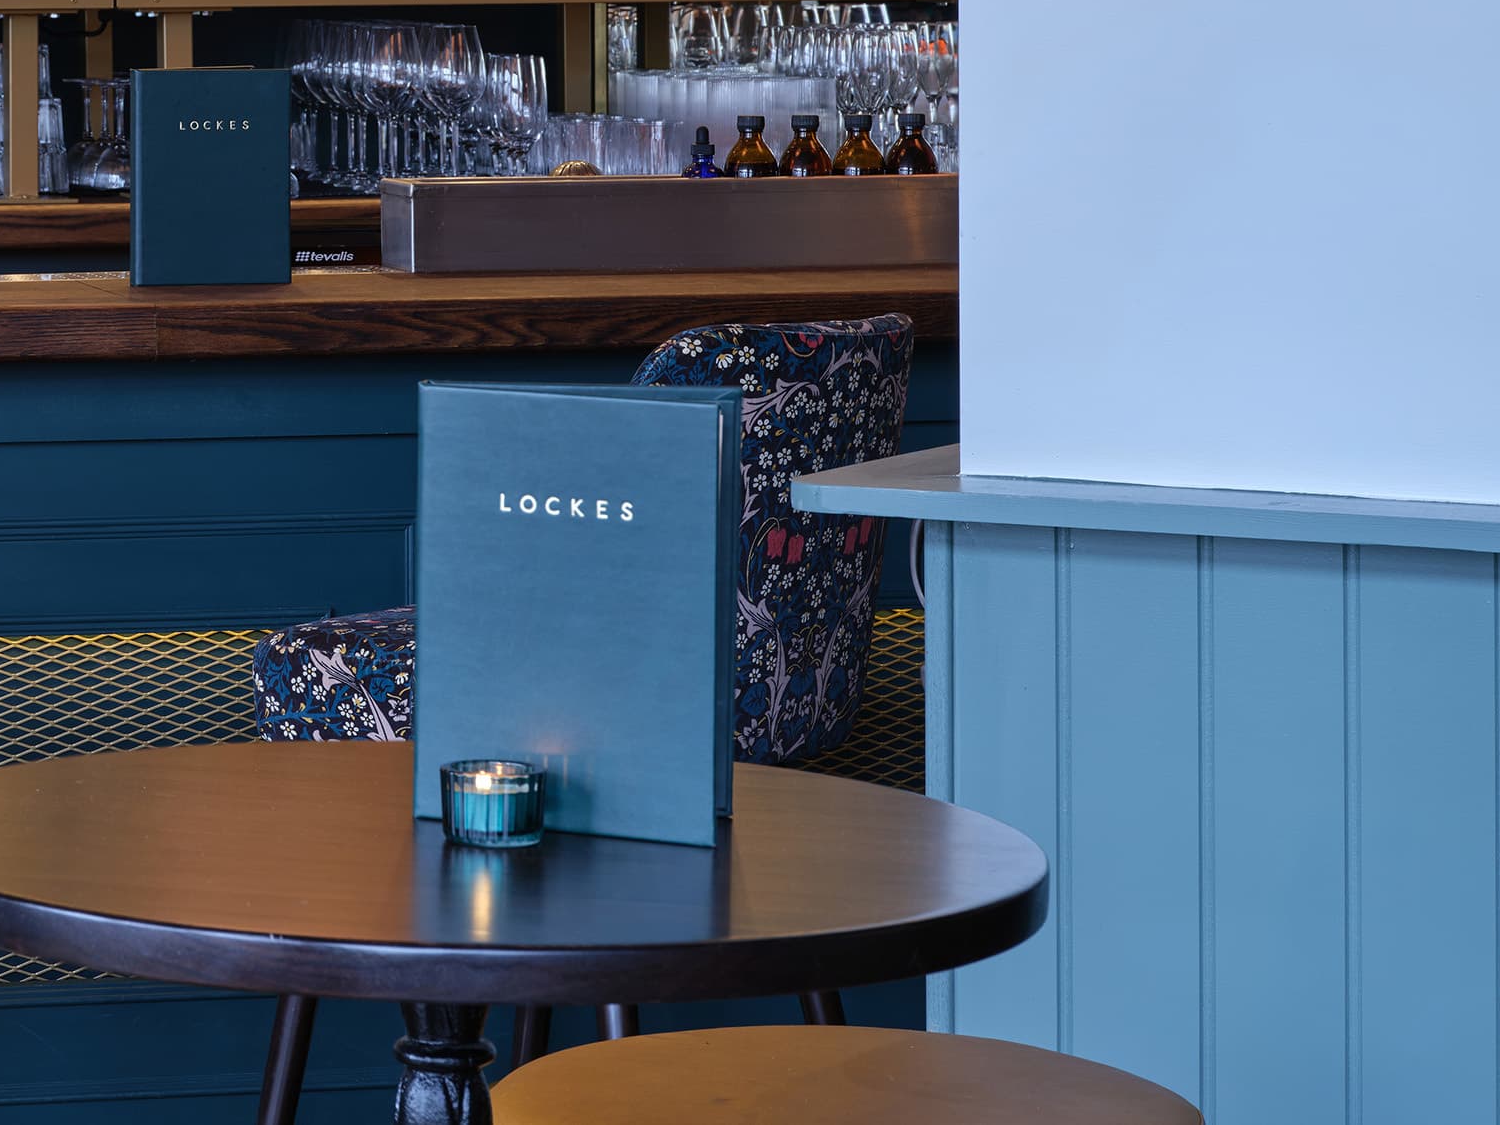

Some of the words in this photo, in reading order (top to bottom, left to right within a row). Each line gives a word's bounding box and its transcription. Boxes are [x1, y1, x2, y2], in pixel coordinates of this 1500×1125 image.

[179, 120, 250, 131] LOCKES
[310, 251, 355, 263] tevalis
[498, 491, 635, 523] LOCKES
